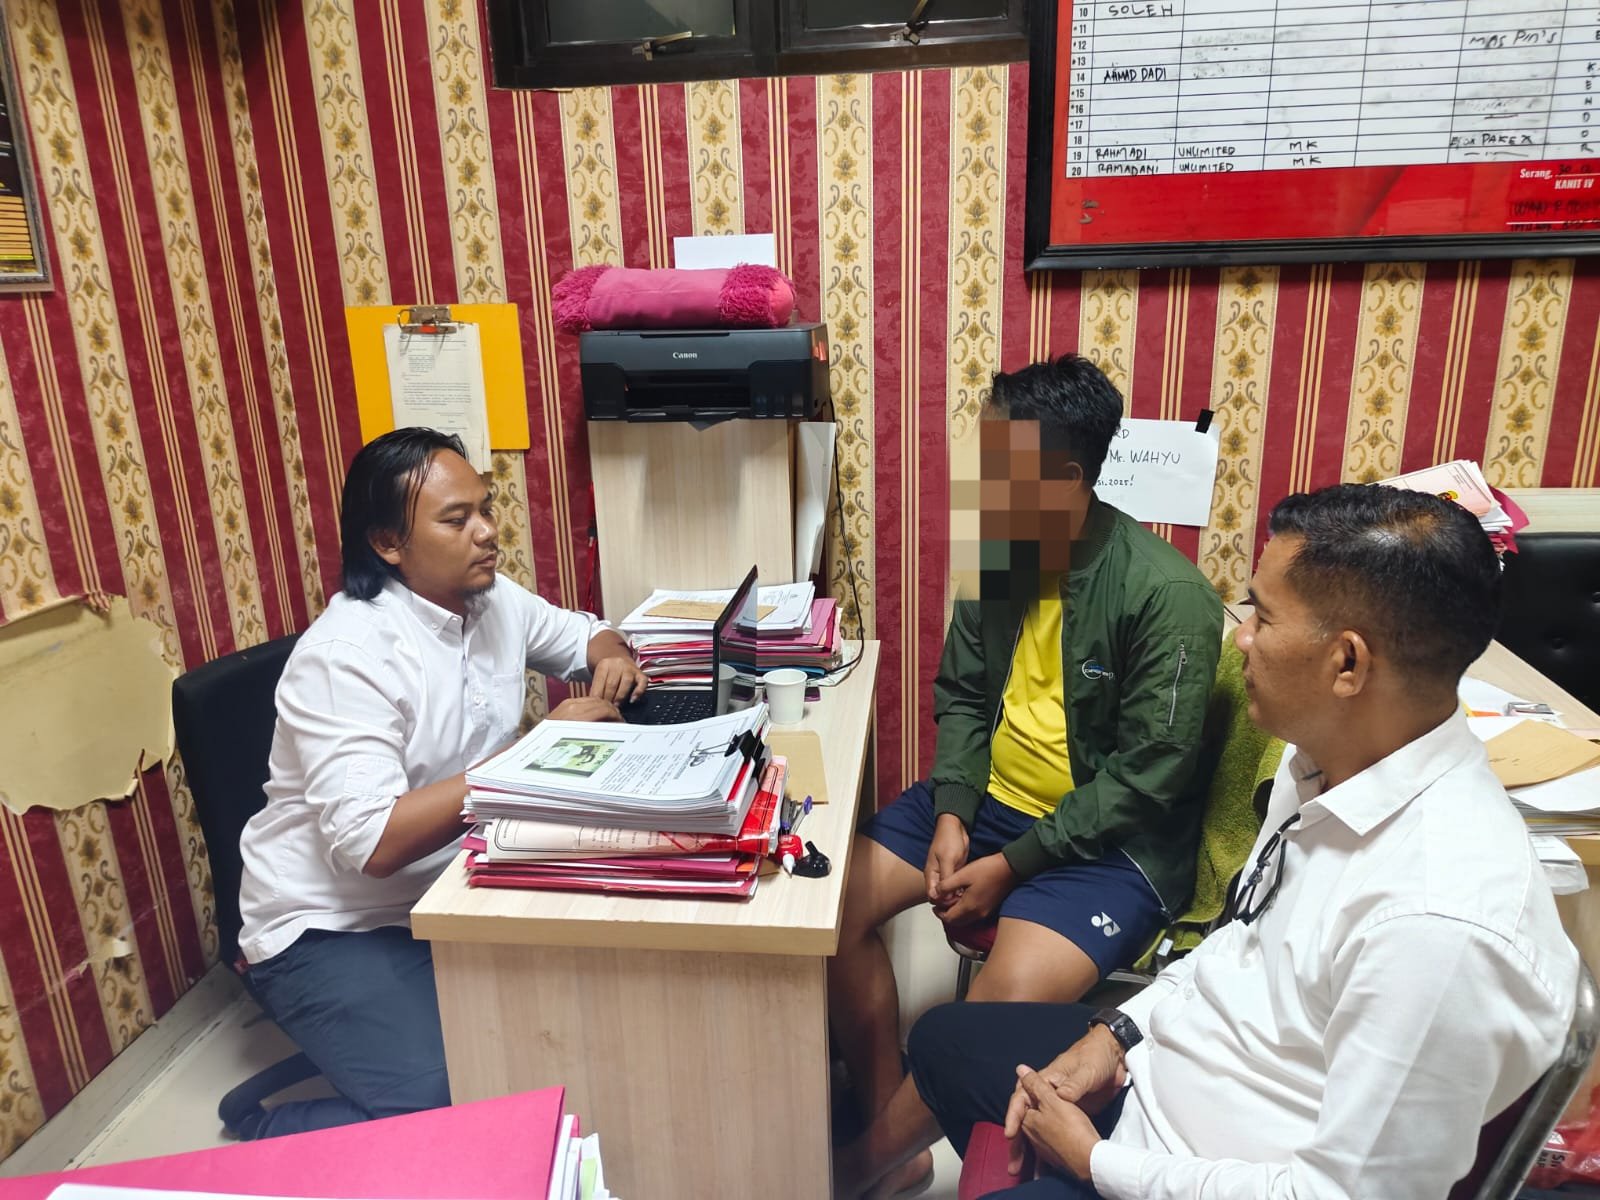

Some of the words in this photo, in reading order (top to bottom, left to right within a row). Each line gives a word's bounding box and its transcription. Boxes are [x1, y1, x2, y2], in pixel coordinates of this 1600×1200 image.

[1079, 7, 1088, 17] 10
[1108, 3, 1174, 17] SOLEH
[1079, 24, 1087, 34] 11
[1078, 40, 1087, 50] 12
[1077, 57, 1086, 66] 13
[1076, 73, 1085, 82] 14
[1141, 67, 1167, 82] DADI
[1076, 89, 1085, 98] 15
[1075, 104, 1084, 114] 16
[1075, 120, 1083, 129] 17
[1074, 135, 1083, 145] 18
[1073, 151, 1082, 160] 19
[1178, 145, 1236, 158] UNLIMITED
[1072, 166, 1082, 176] 20
[1179, 162, 1234, 173] UNLIMITED
[672, 351, 698, 360] Canon
[1130, 449, 1181, 466] WAHYU
